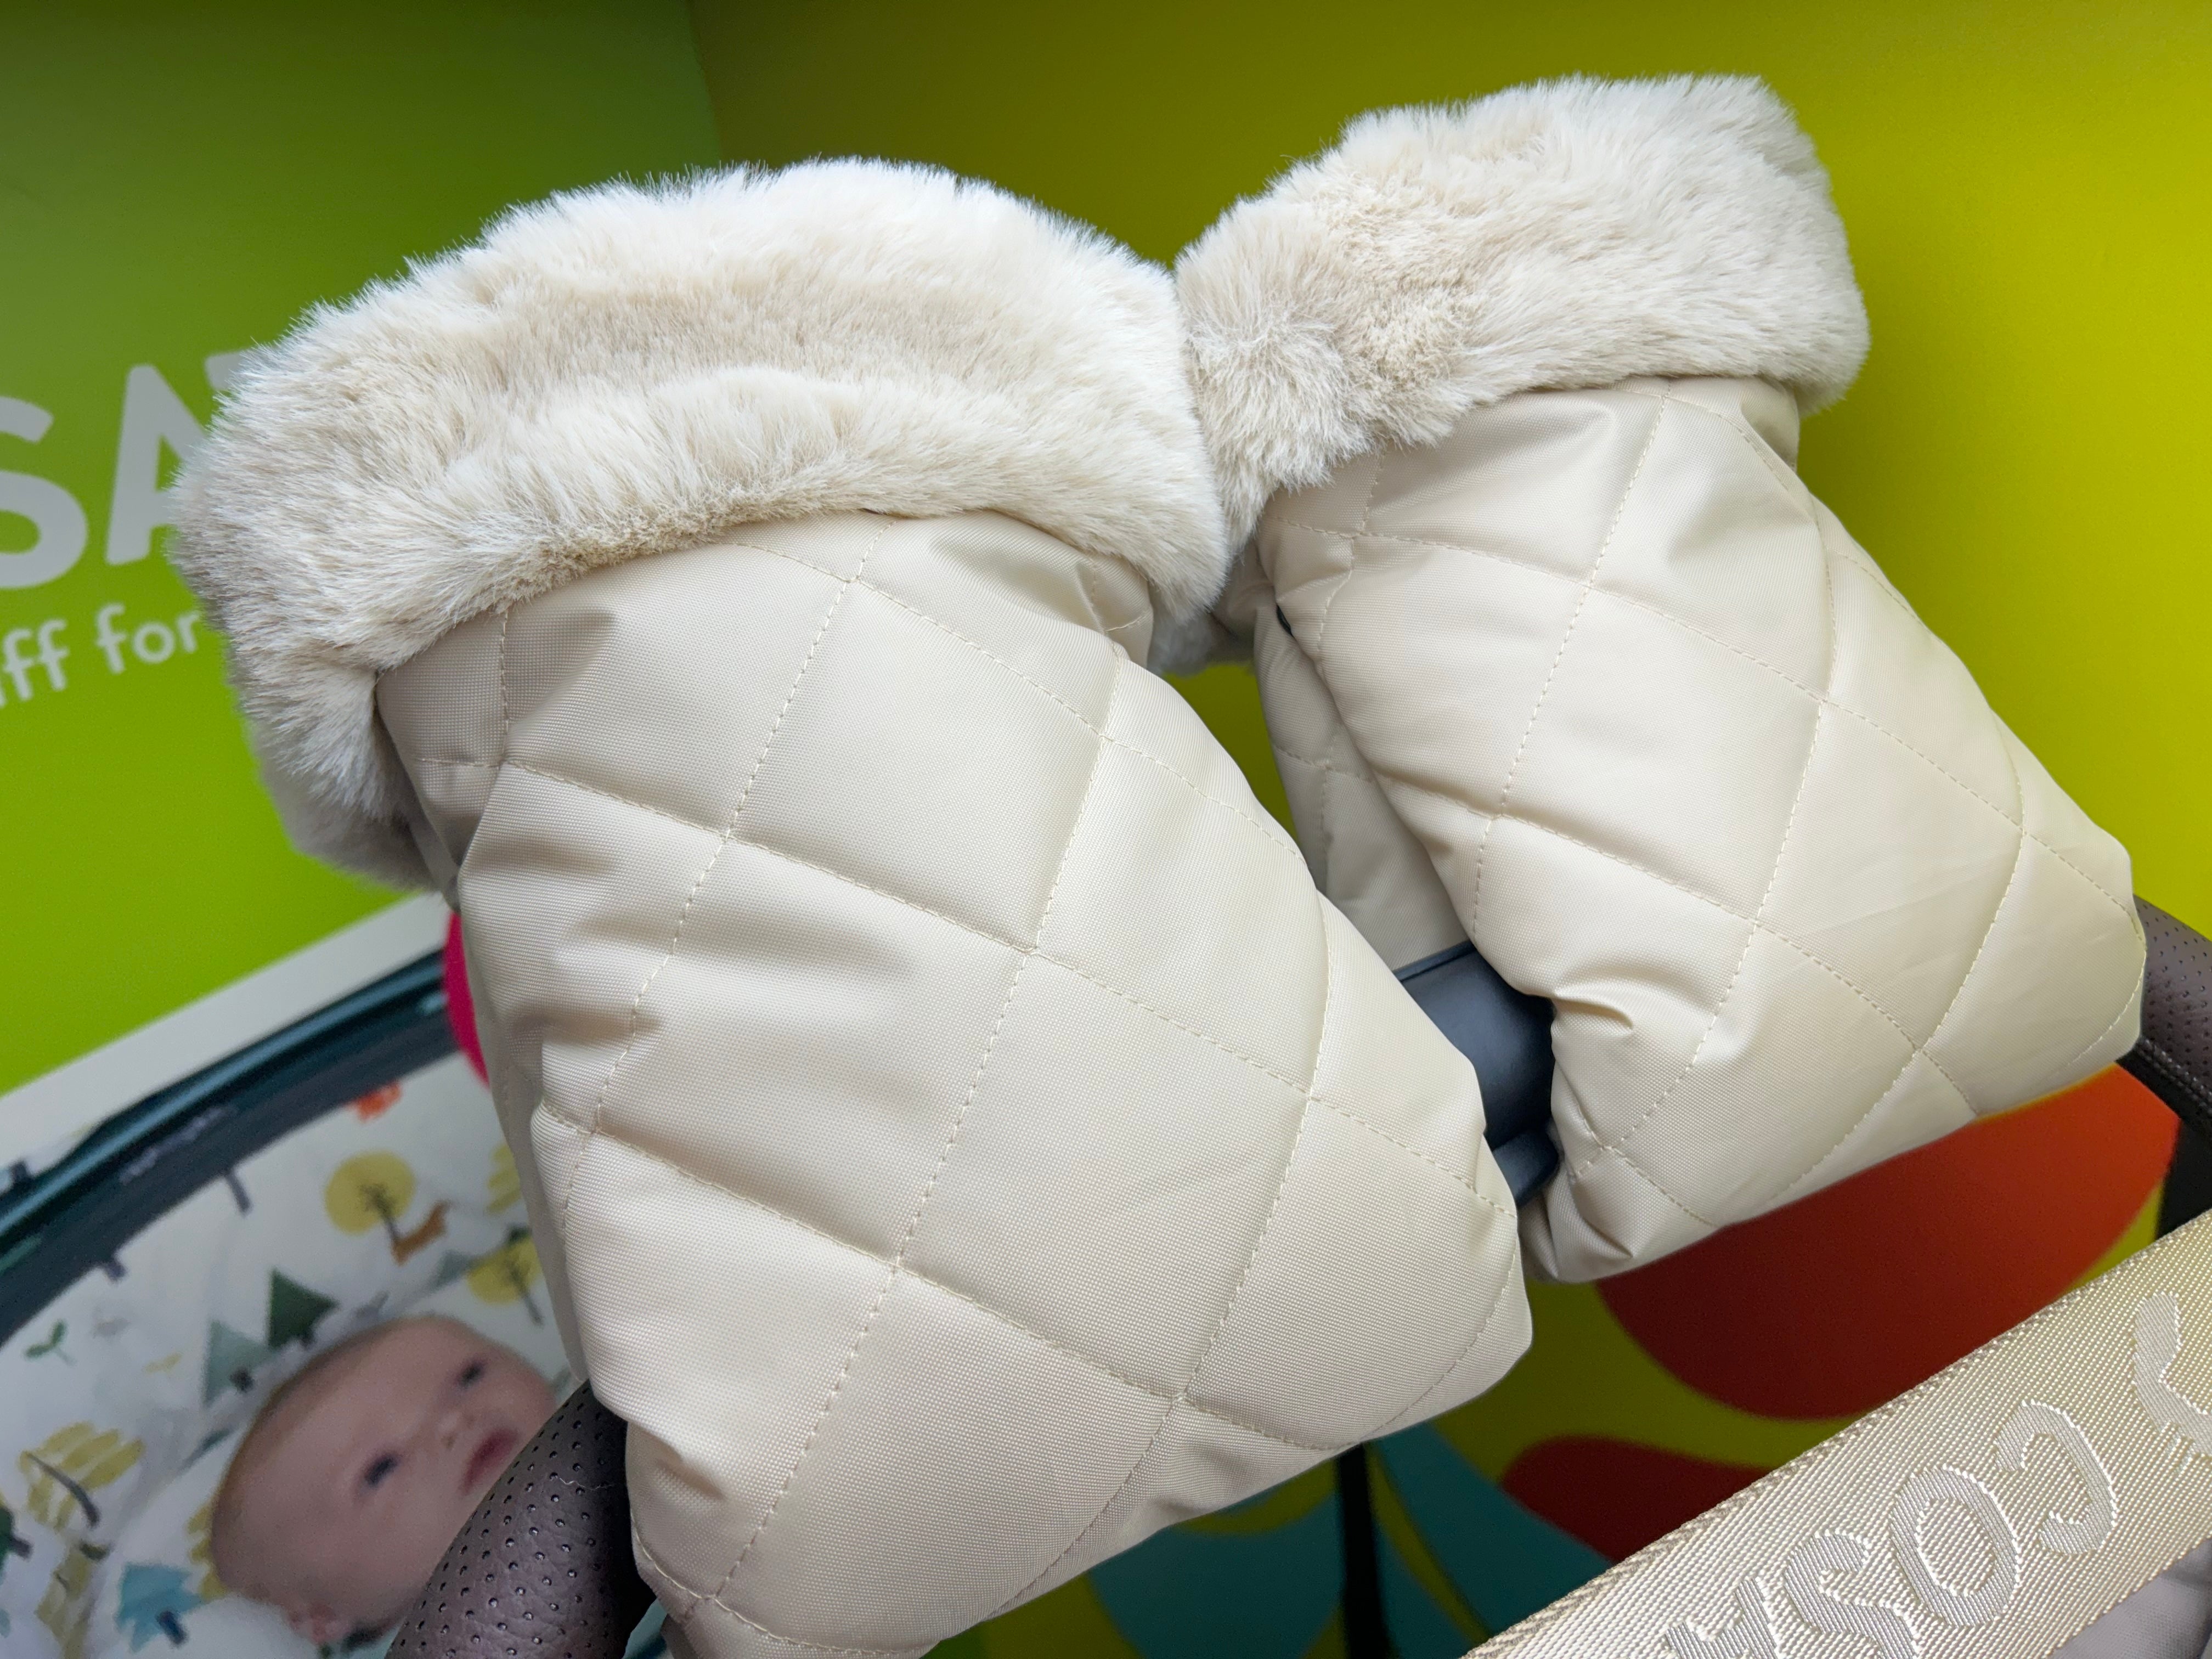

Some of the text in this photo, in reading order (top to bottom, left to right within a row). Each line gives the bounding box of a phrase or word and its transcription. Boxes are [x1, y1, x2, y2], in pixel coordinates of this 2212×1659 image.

[0, 348, 253, 590] SA
[0, 603, 199, 708] ff for
